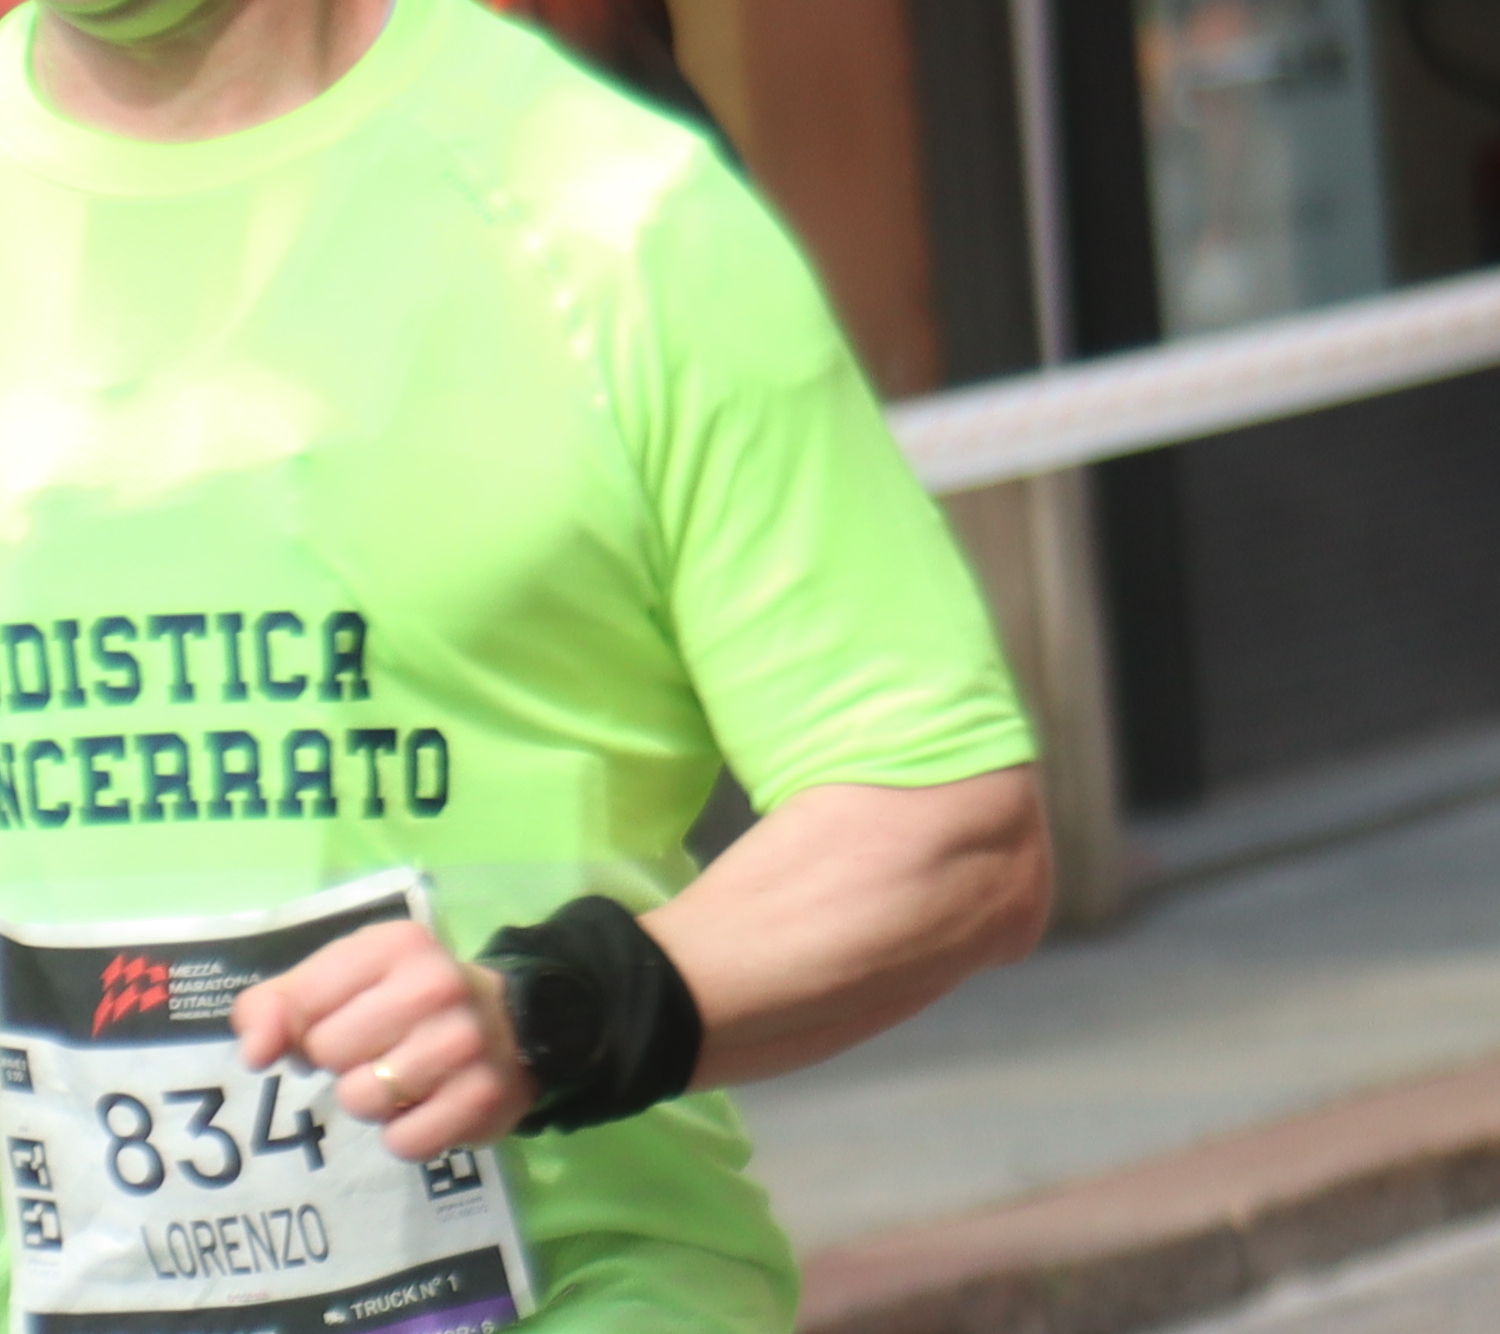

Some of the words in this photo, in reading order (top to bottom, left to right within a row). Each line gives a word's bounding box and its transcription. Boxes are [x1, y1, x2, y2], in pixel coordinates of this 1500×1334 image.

[168, 962, 222, 979] MEZZA
[168, 972, 261, 994] MARATONA
[94, 1074, 326, 1197] 834
[140, 1203, 330, 1280] LORENZO
[350, 1285, 419, 1320] TRUCK
[447, 1273, 460, 1292] 1
